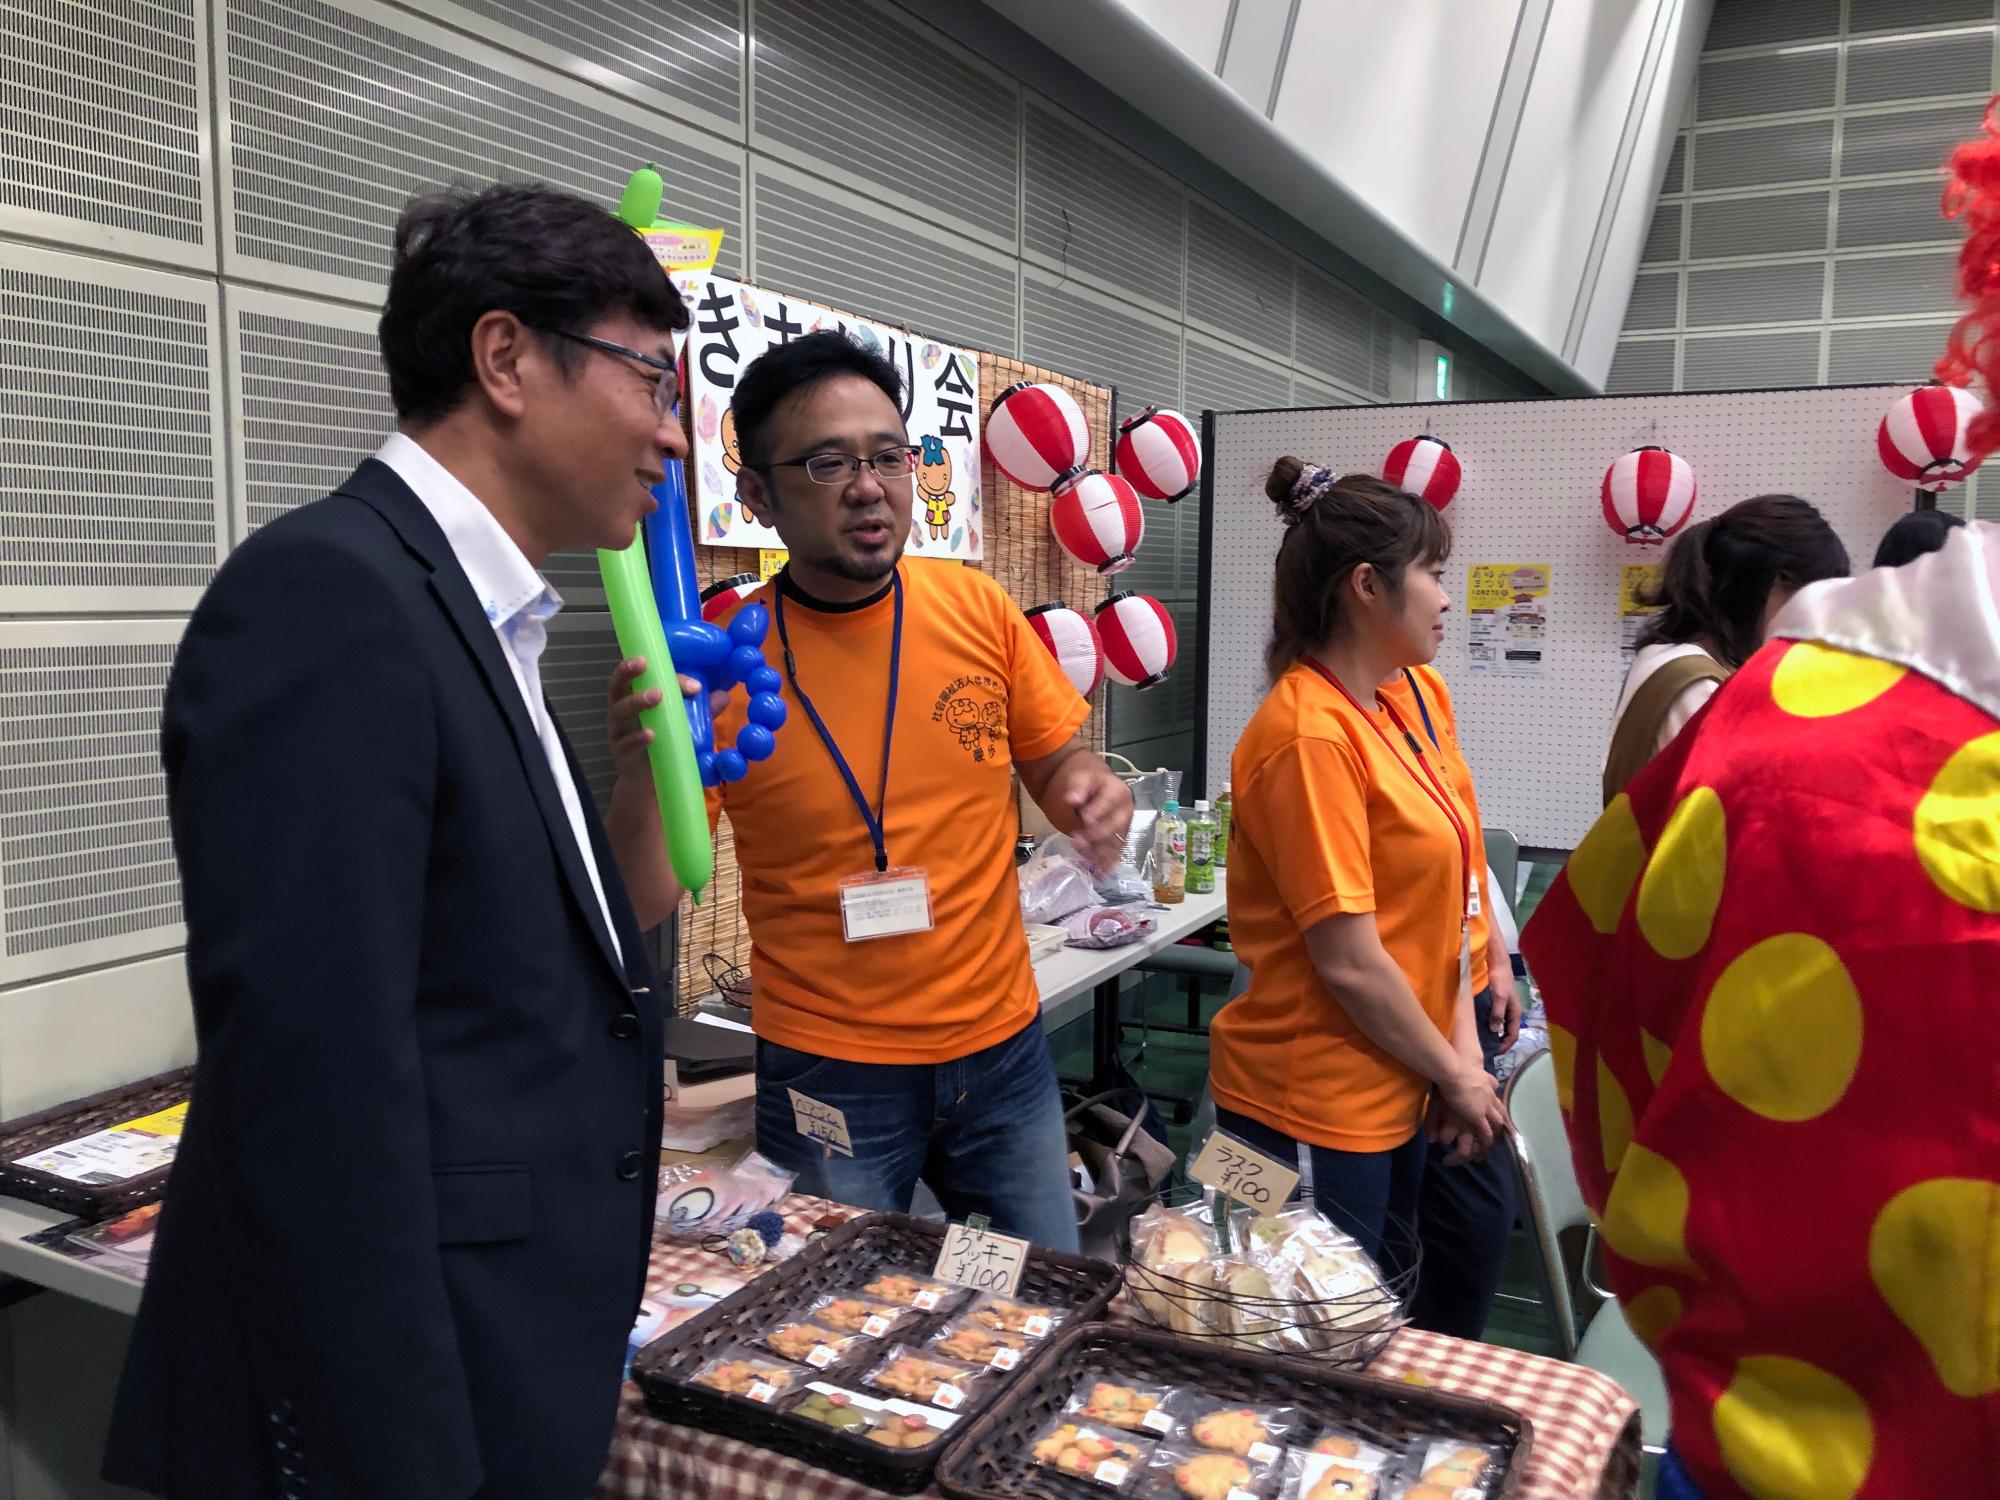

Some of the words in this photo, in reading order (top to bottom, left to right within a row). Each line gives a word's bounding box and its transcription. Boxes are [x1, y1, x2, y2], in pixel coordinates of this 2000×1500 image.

[1216, 1145, 1263, 1177] ラスク
[1220, 1167, 1271, 1204] ¥100
[952, 1236, 1015, 1266] クッキー
[955, 1259, 1009, 1292] ¥100
